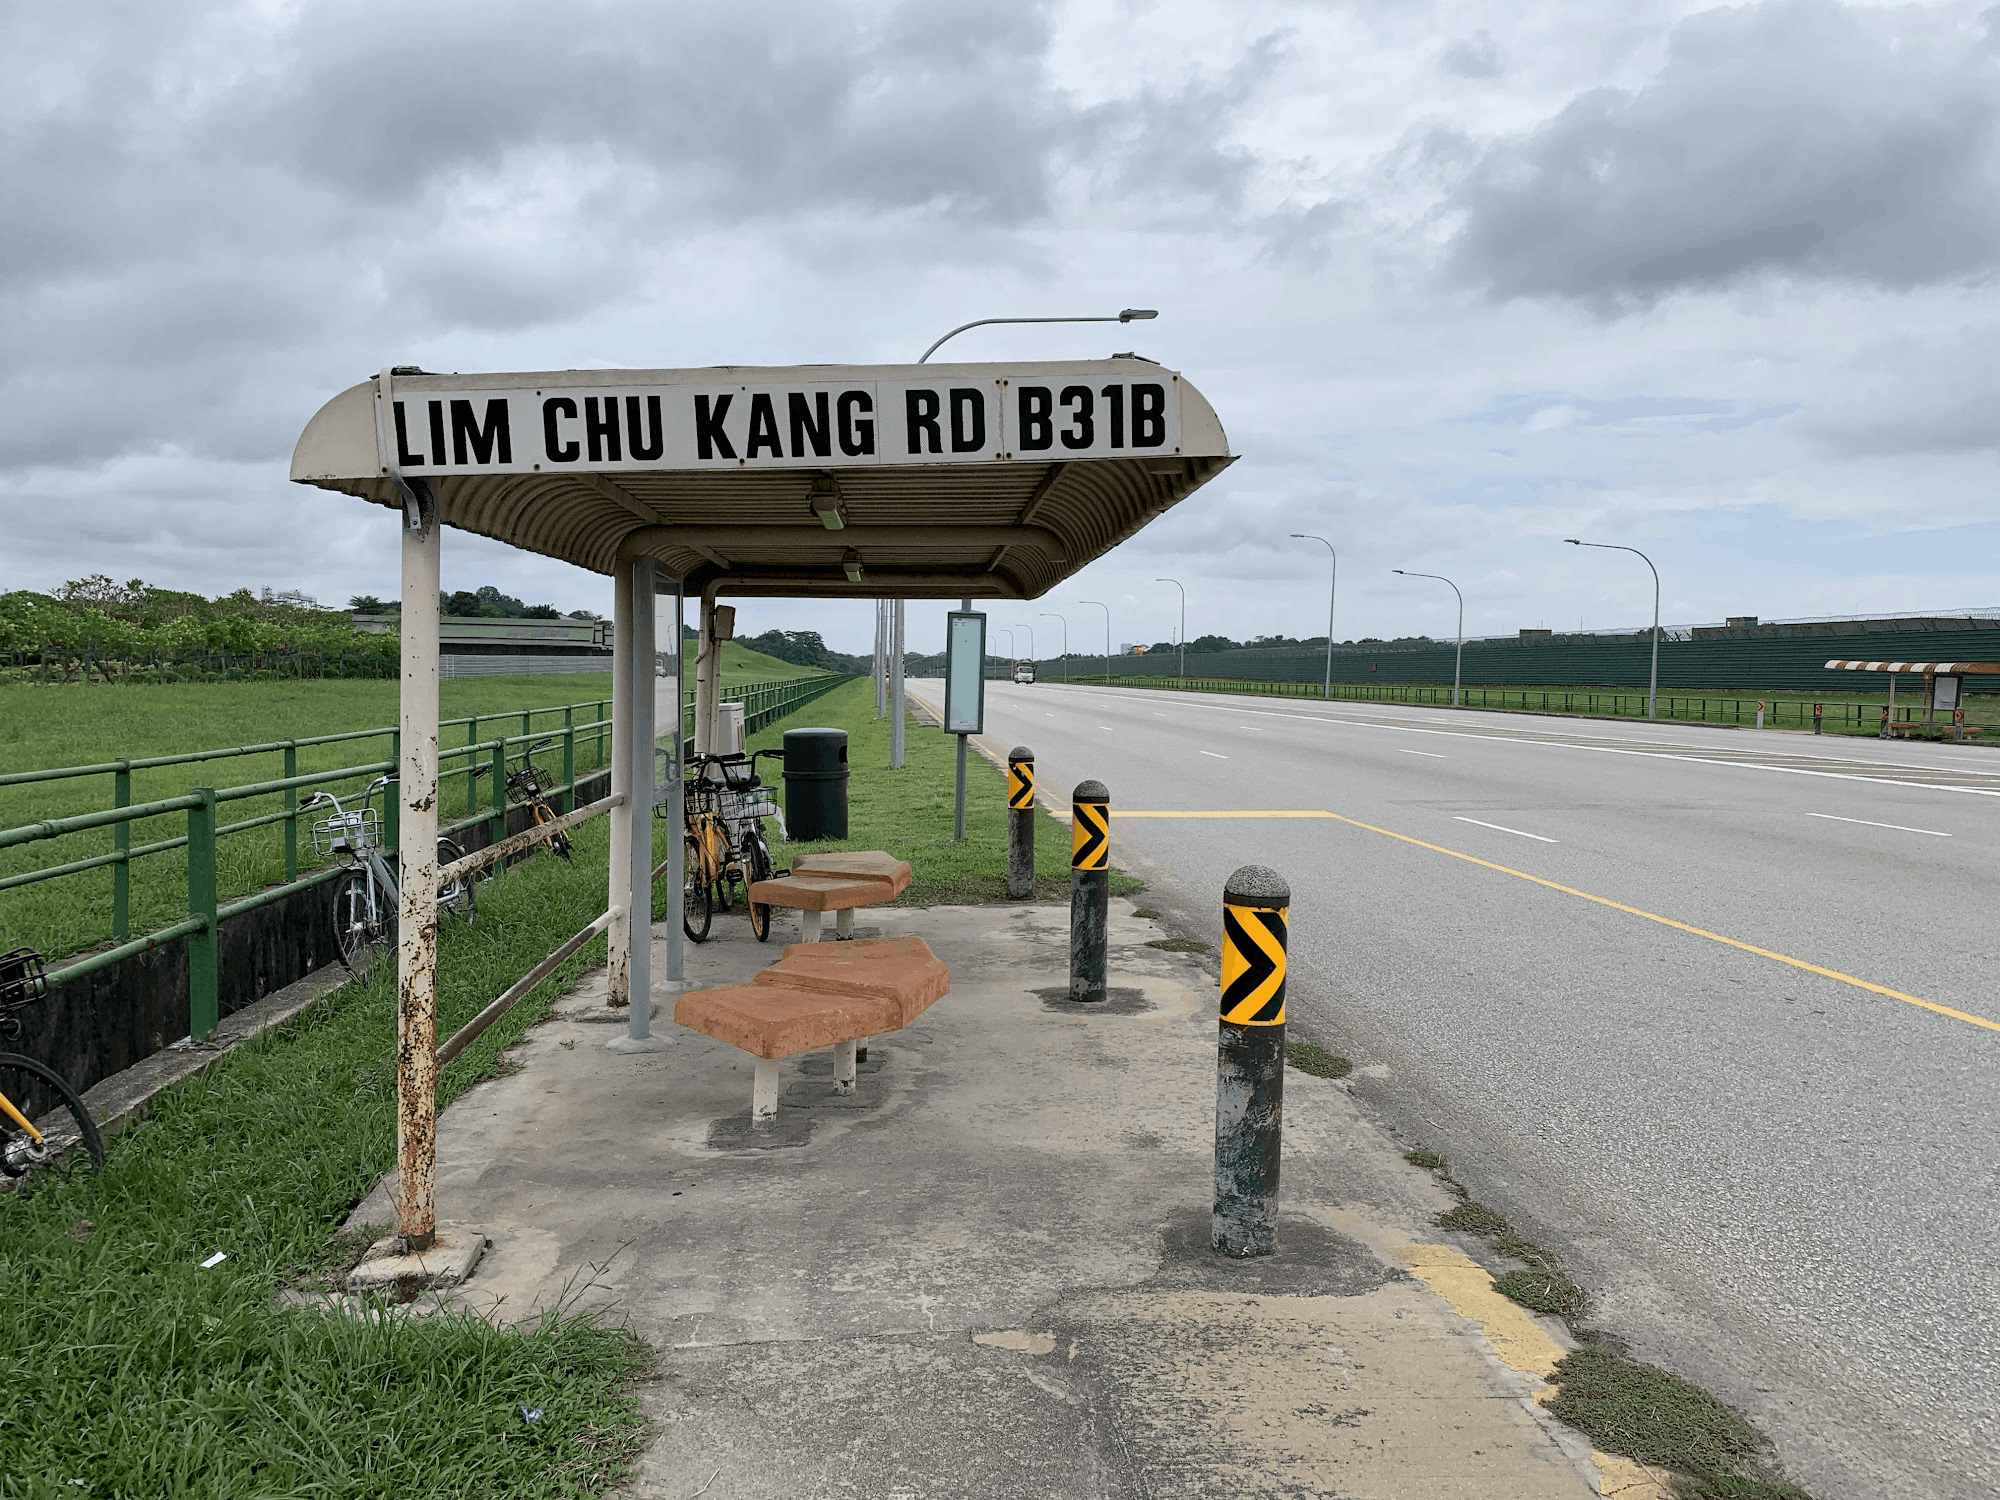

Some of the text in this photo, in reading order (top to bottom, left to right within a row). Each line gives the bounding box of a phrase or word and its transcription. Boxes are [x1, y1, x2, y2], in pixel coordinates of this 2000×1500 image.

[394, 384, 1166, 467] LIM CHU KANG RD B31B
